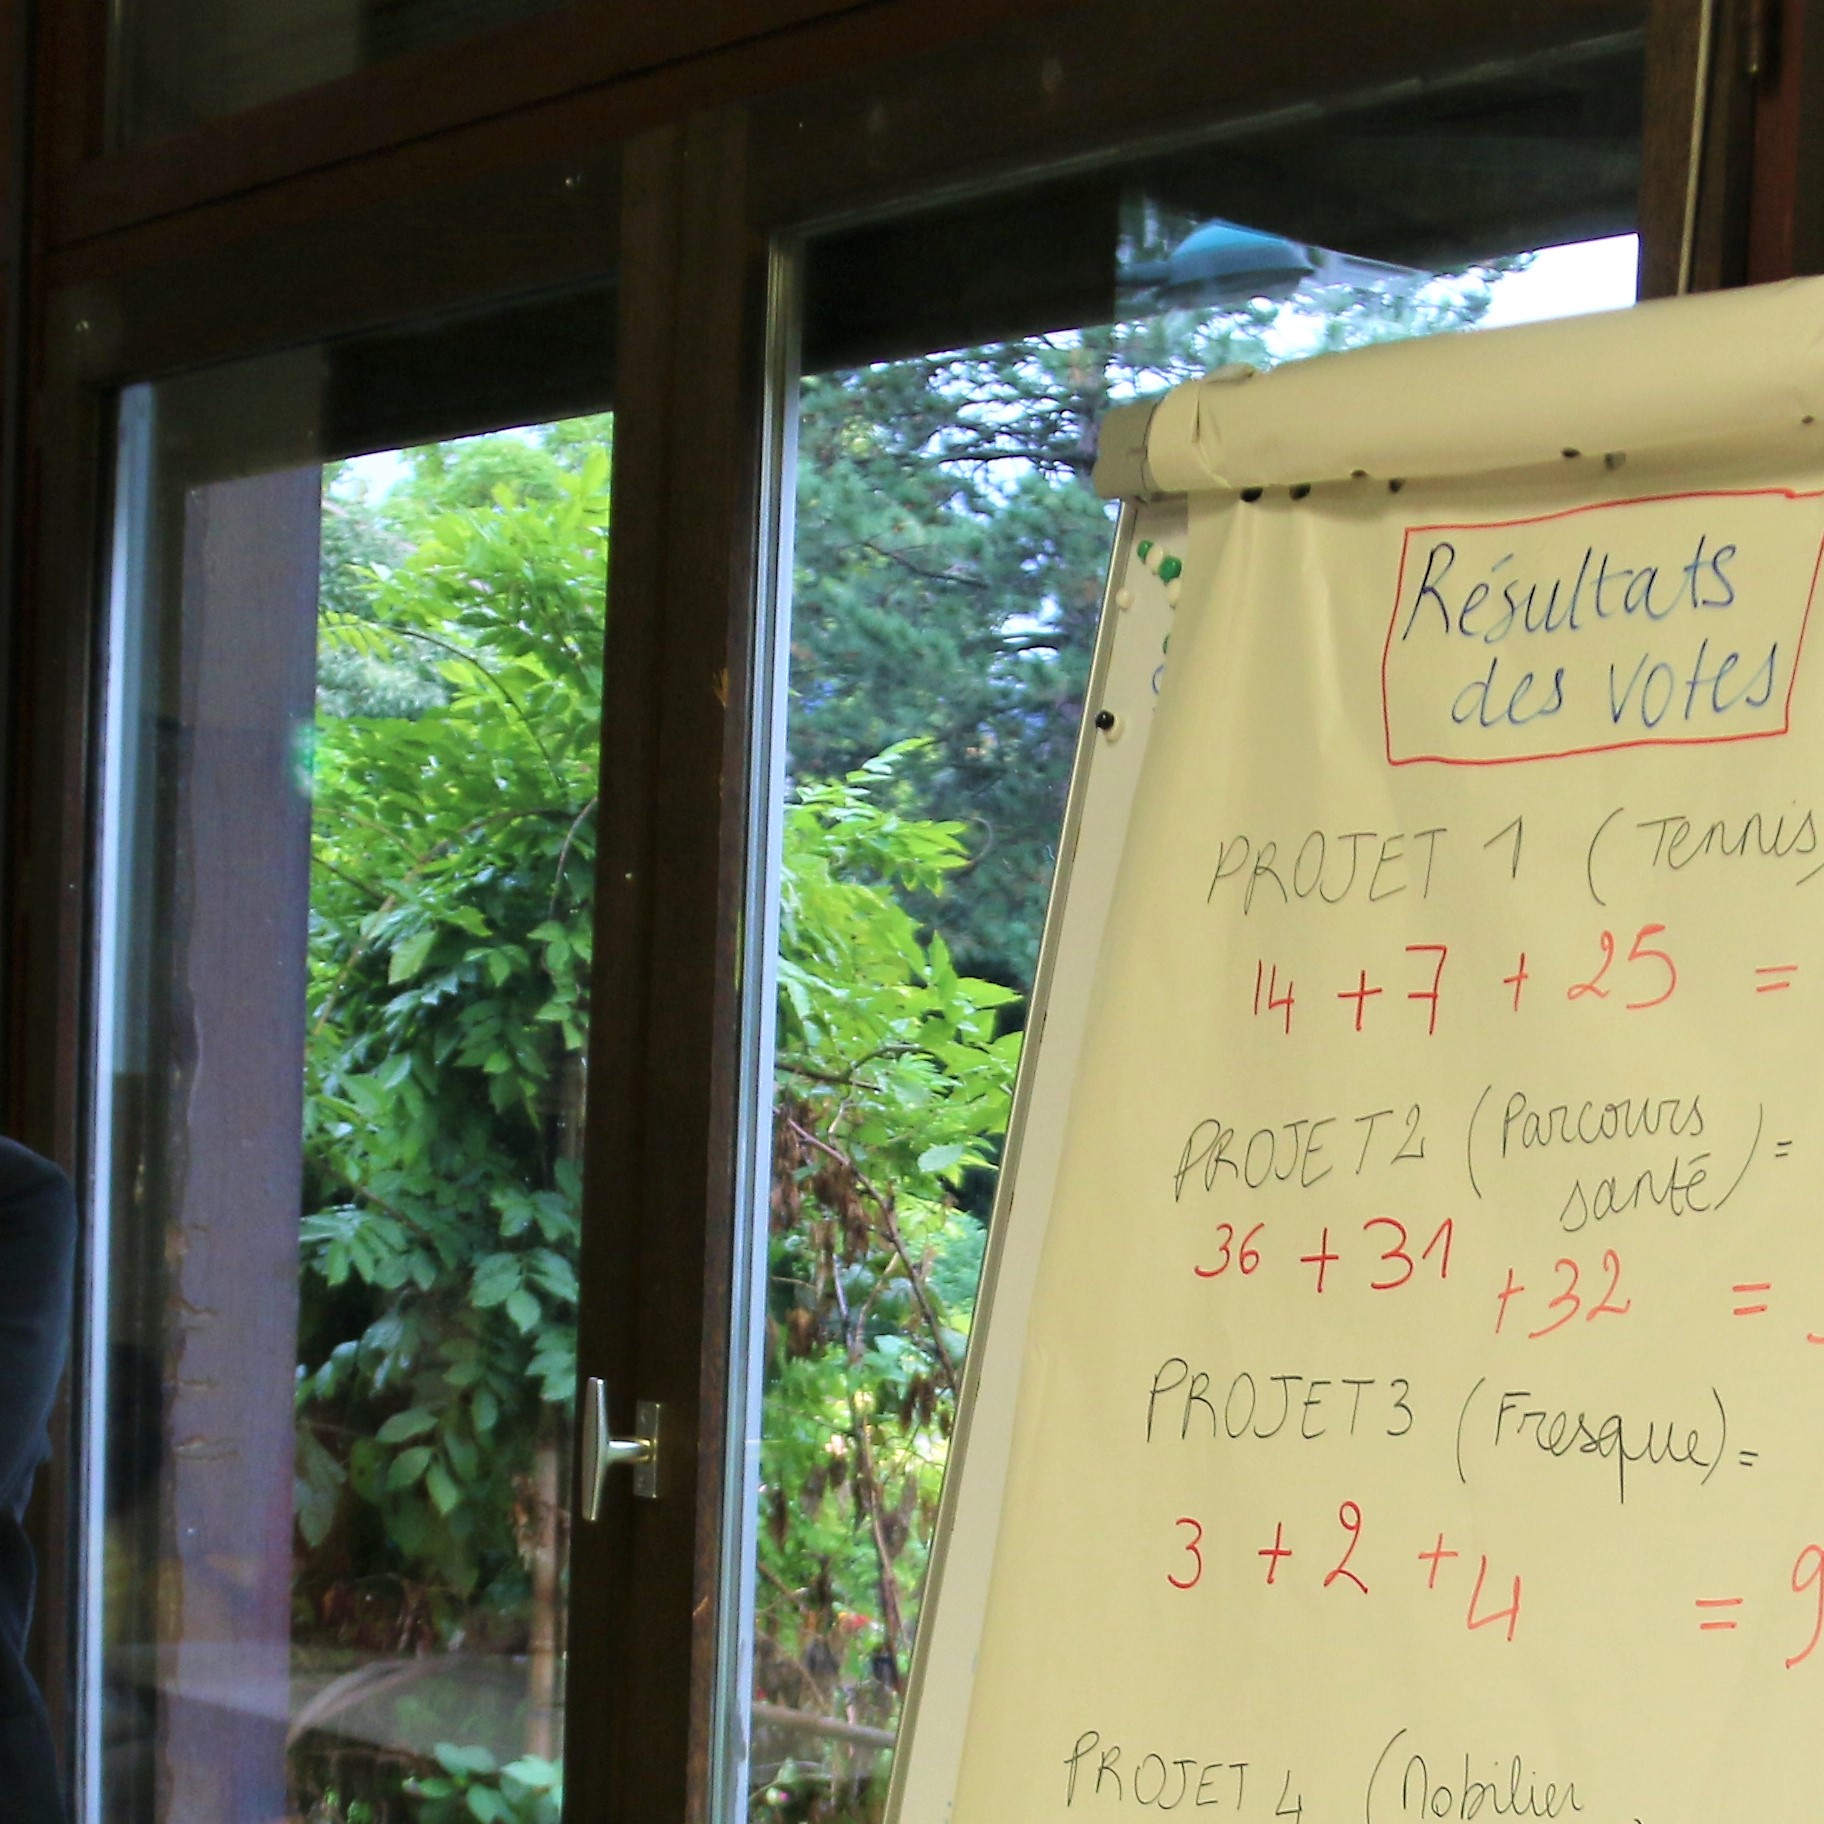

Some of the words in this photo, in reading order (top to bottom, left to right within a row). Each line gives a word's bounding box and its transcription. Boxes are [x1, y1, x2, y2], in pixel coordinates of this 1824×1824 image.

[1402, 534, 1736, 644] Résultats
[1451, 657, 1564, 727] des
[1610, 638, 1778, 729] votes
[1207, 828, 1447, 911] PROJET
[1484, 816, 1523, 879] 1
[1064, 1731, 1248, 1810] PROJET
